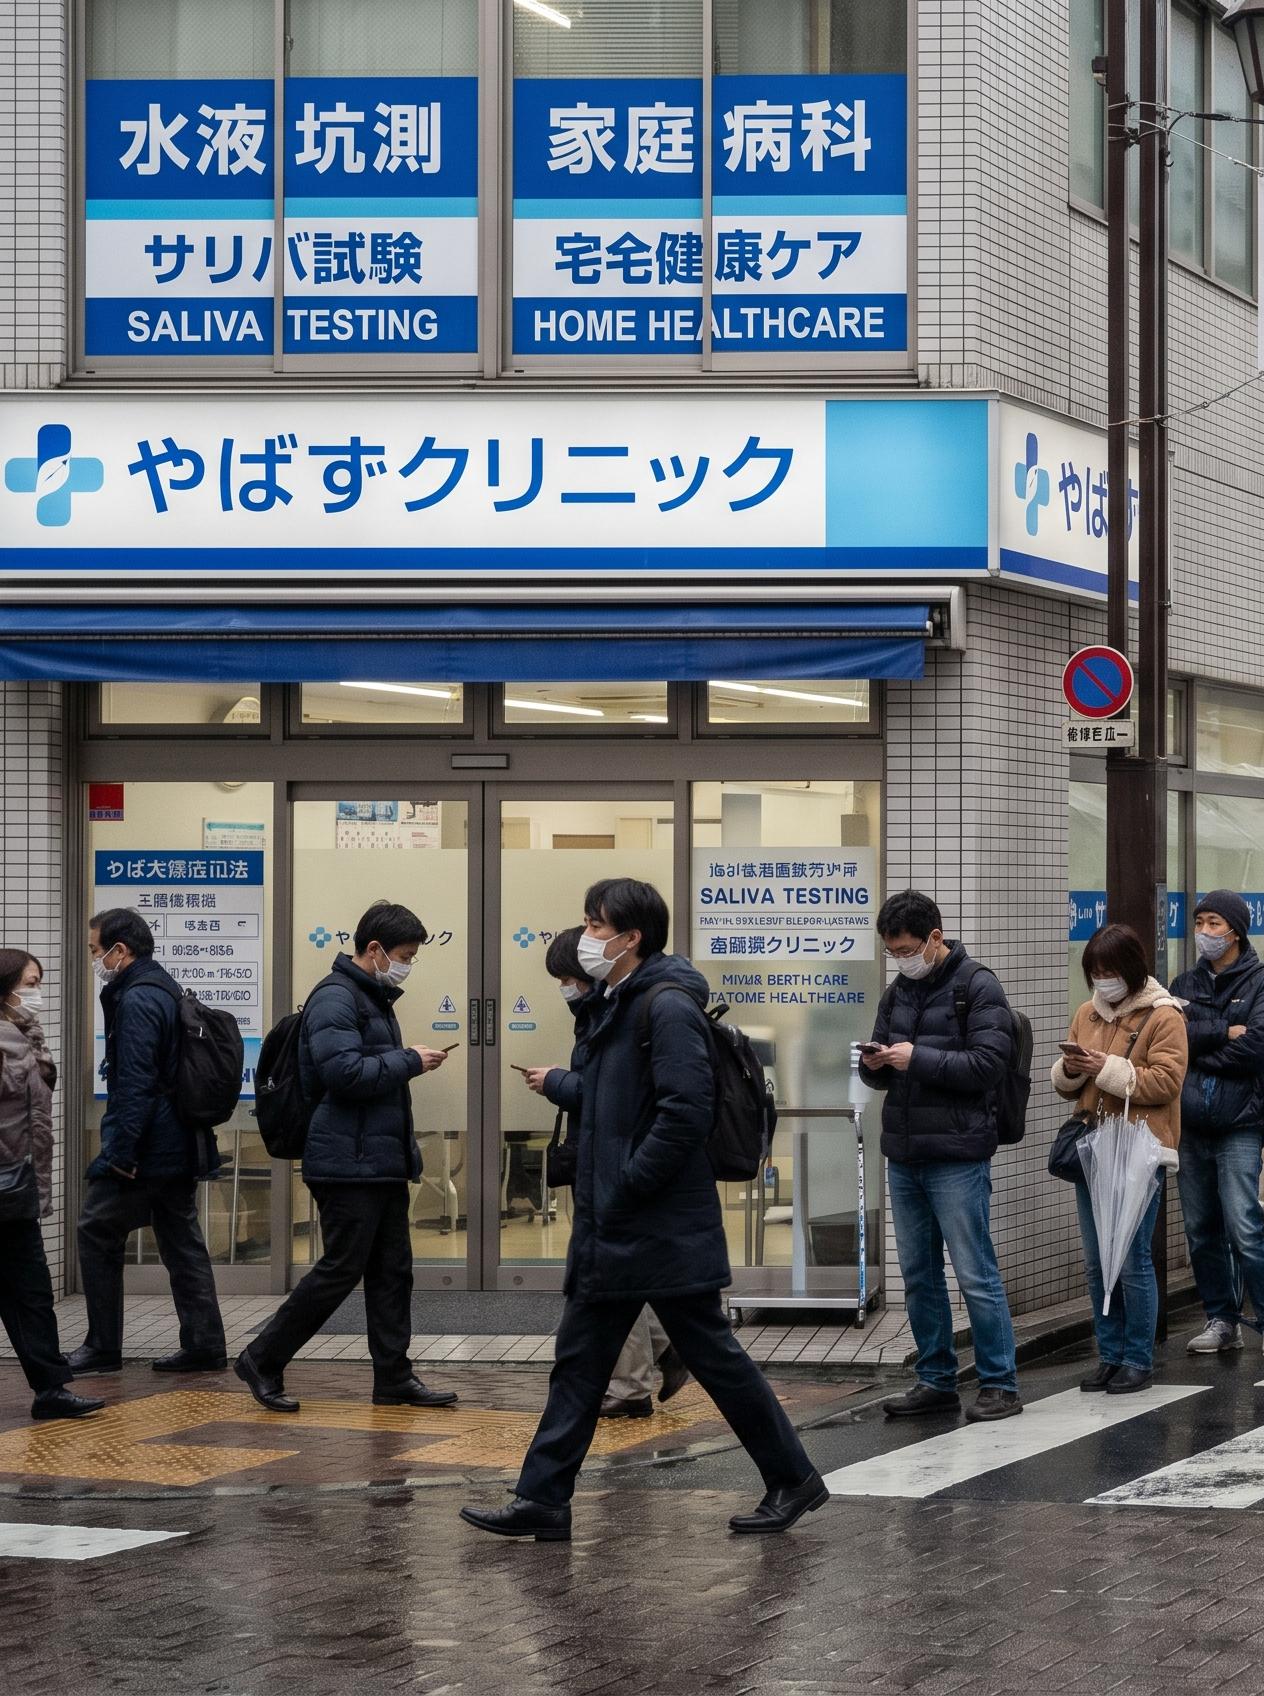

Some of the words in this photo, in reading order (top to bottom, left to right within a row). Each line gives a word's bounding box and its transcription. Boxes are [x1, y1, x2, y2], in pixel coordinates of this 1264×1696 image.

[145, 231, 422, 285] サリバ試験
[127, 310, 264, 342] SALIVA
[287, 308, 438, 341] TESTING
[534, 310, 636, 341] HOME
[649, 306, 885, 341] HEALTHCARE
[128, 433, 794, 514] やばずクリニック
[701, 887, 775, 905] SALIVA
[783, 887, 869, 905] TESTING
[815, 974, 849, 986] CARE
